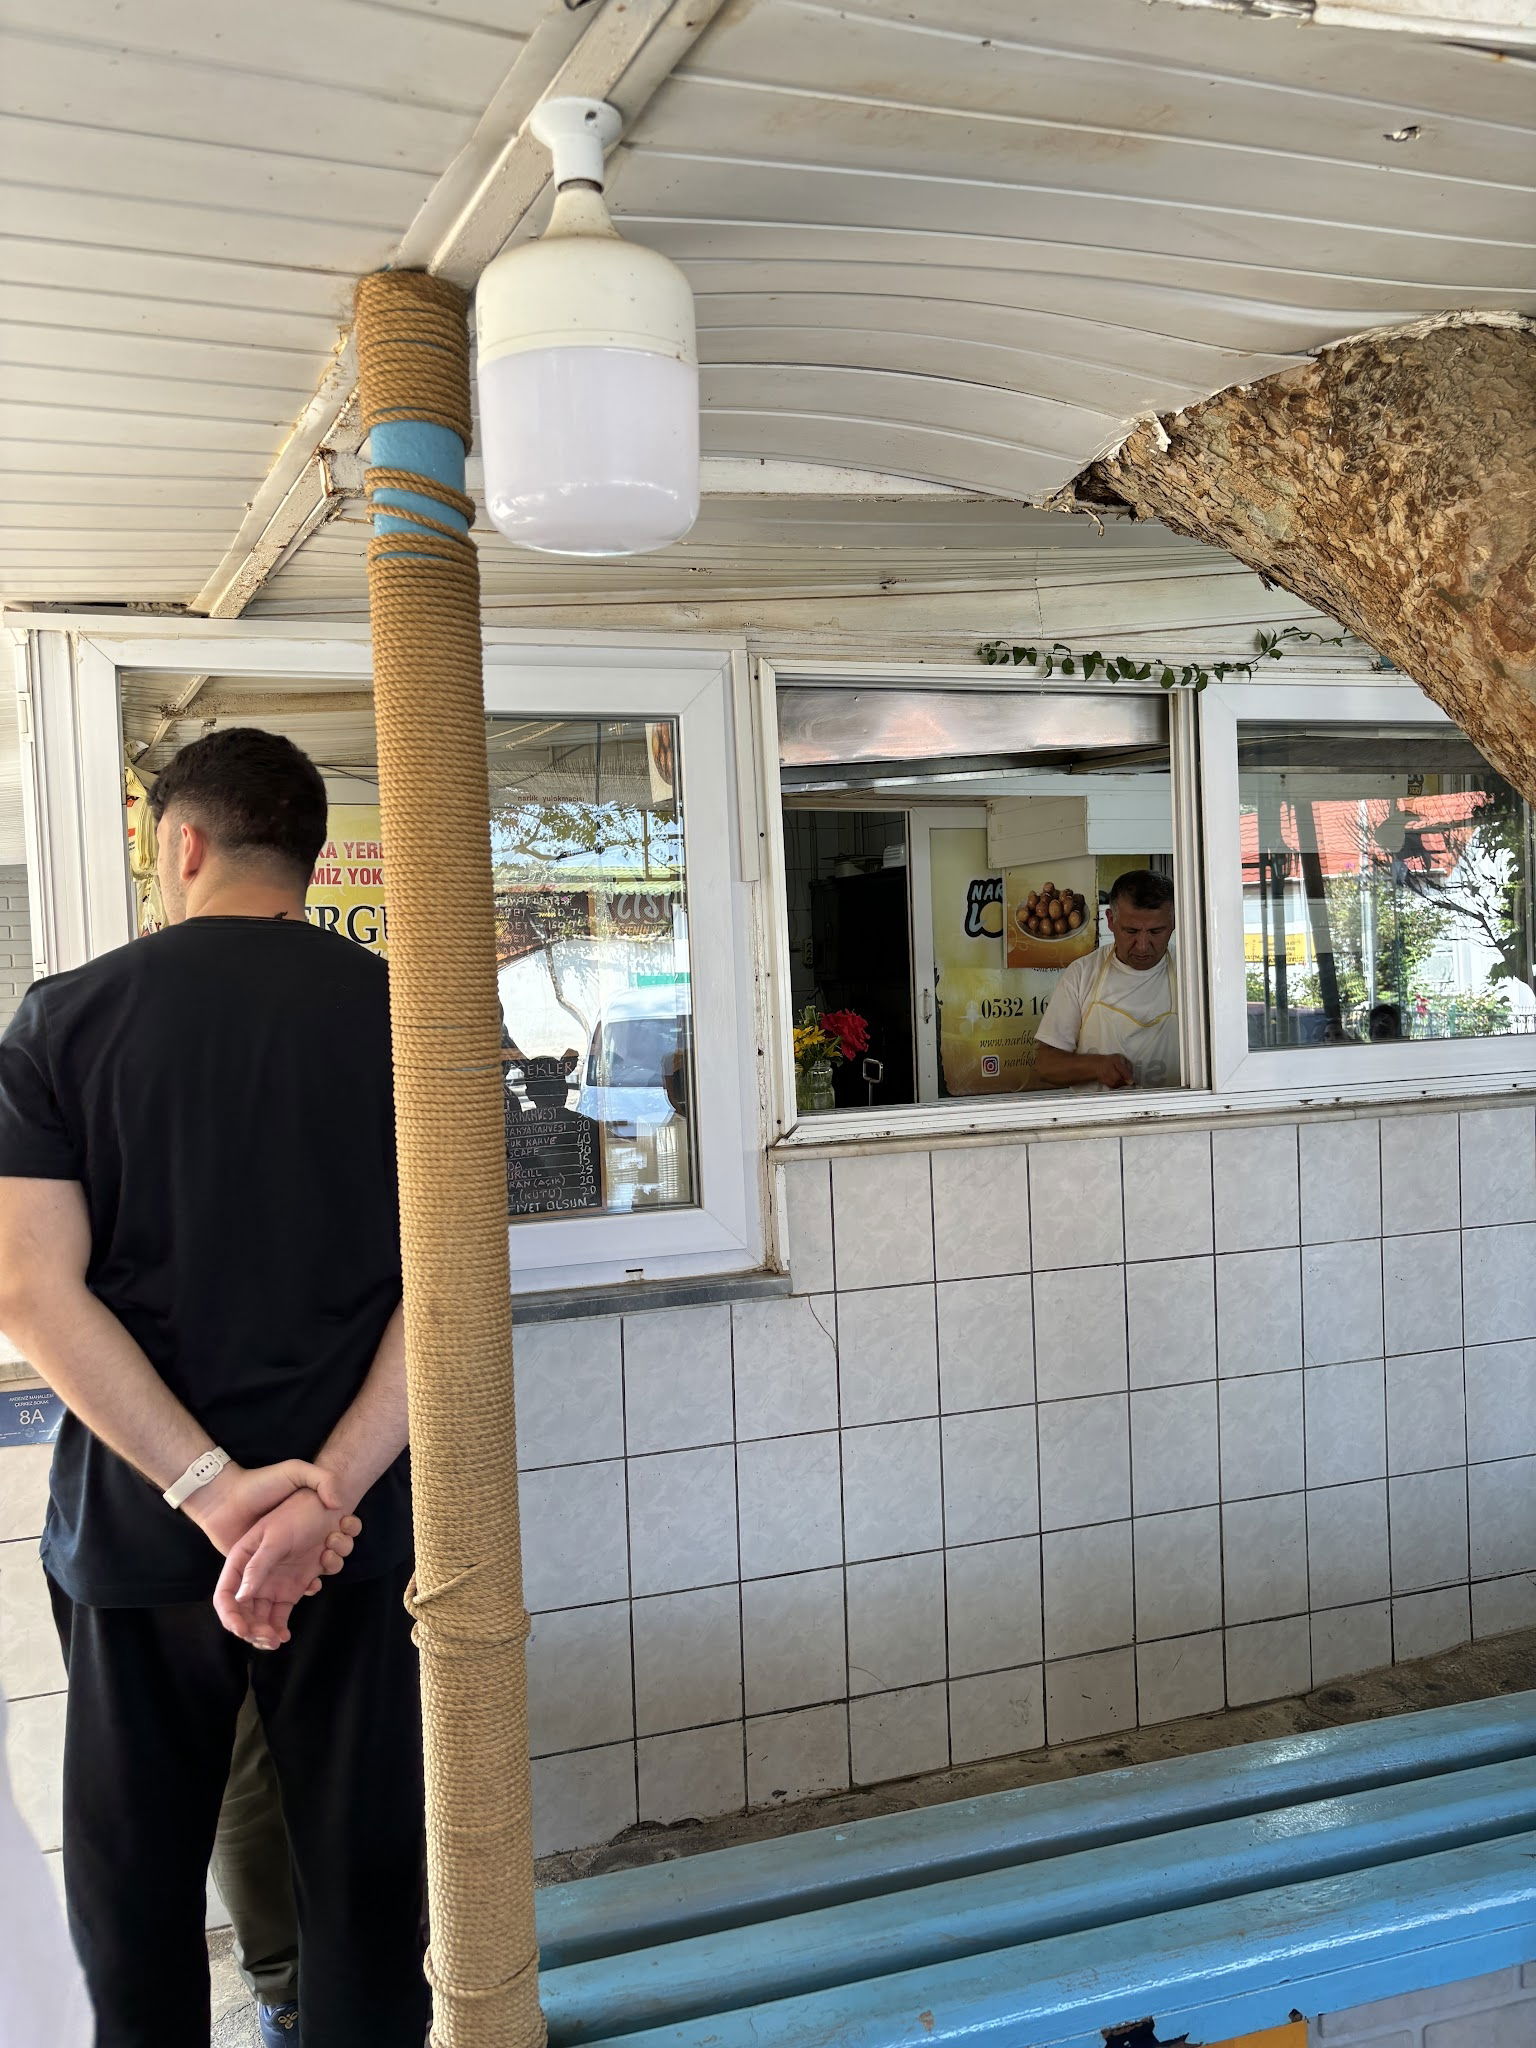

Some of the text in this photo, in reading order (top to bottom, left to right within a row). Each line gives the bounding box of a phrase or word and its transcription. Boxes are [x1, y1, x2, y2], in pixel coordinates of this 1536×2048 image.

[348, 868, 384, 885] YOK
[981, 997, 1024, 1019] 0532
[526, 1136, 558, 1147] KAHVE
[579, 1175, 595, 1186] 20
[580, 1185, 597, 1196] 20
[20, 1409, 45, 1425] 8A
